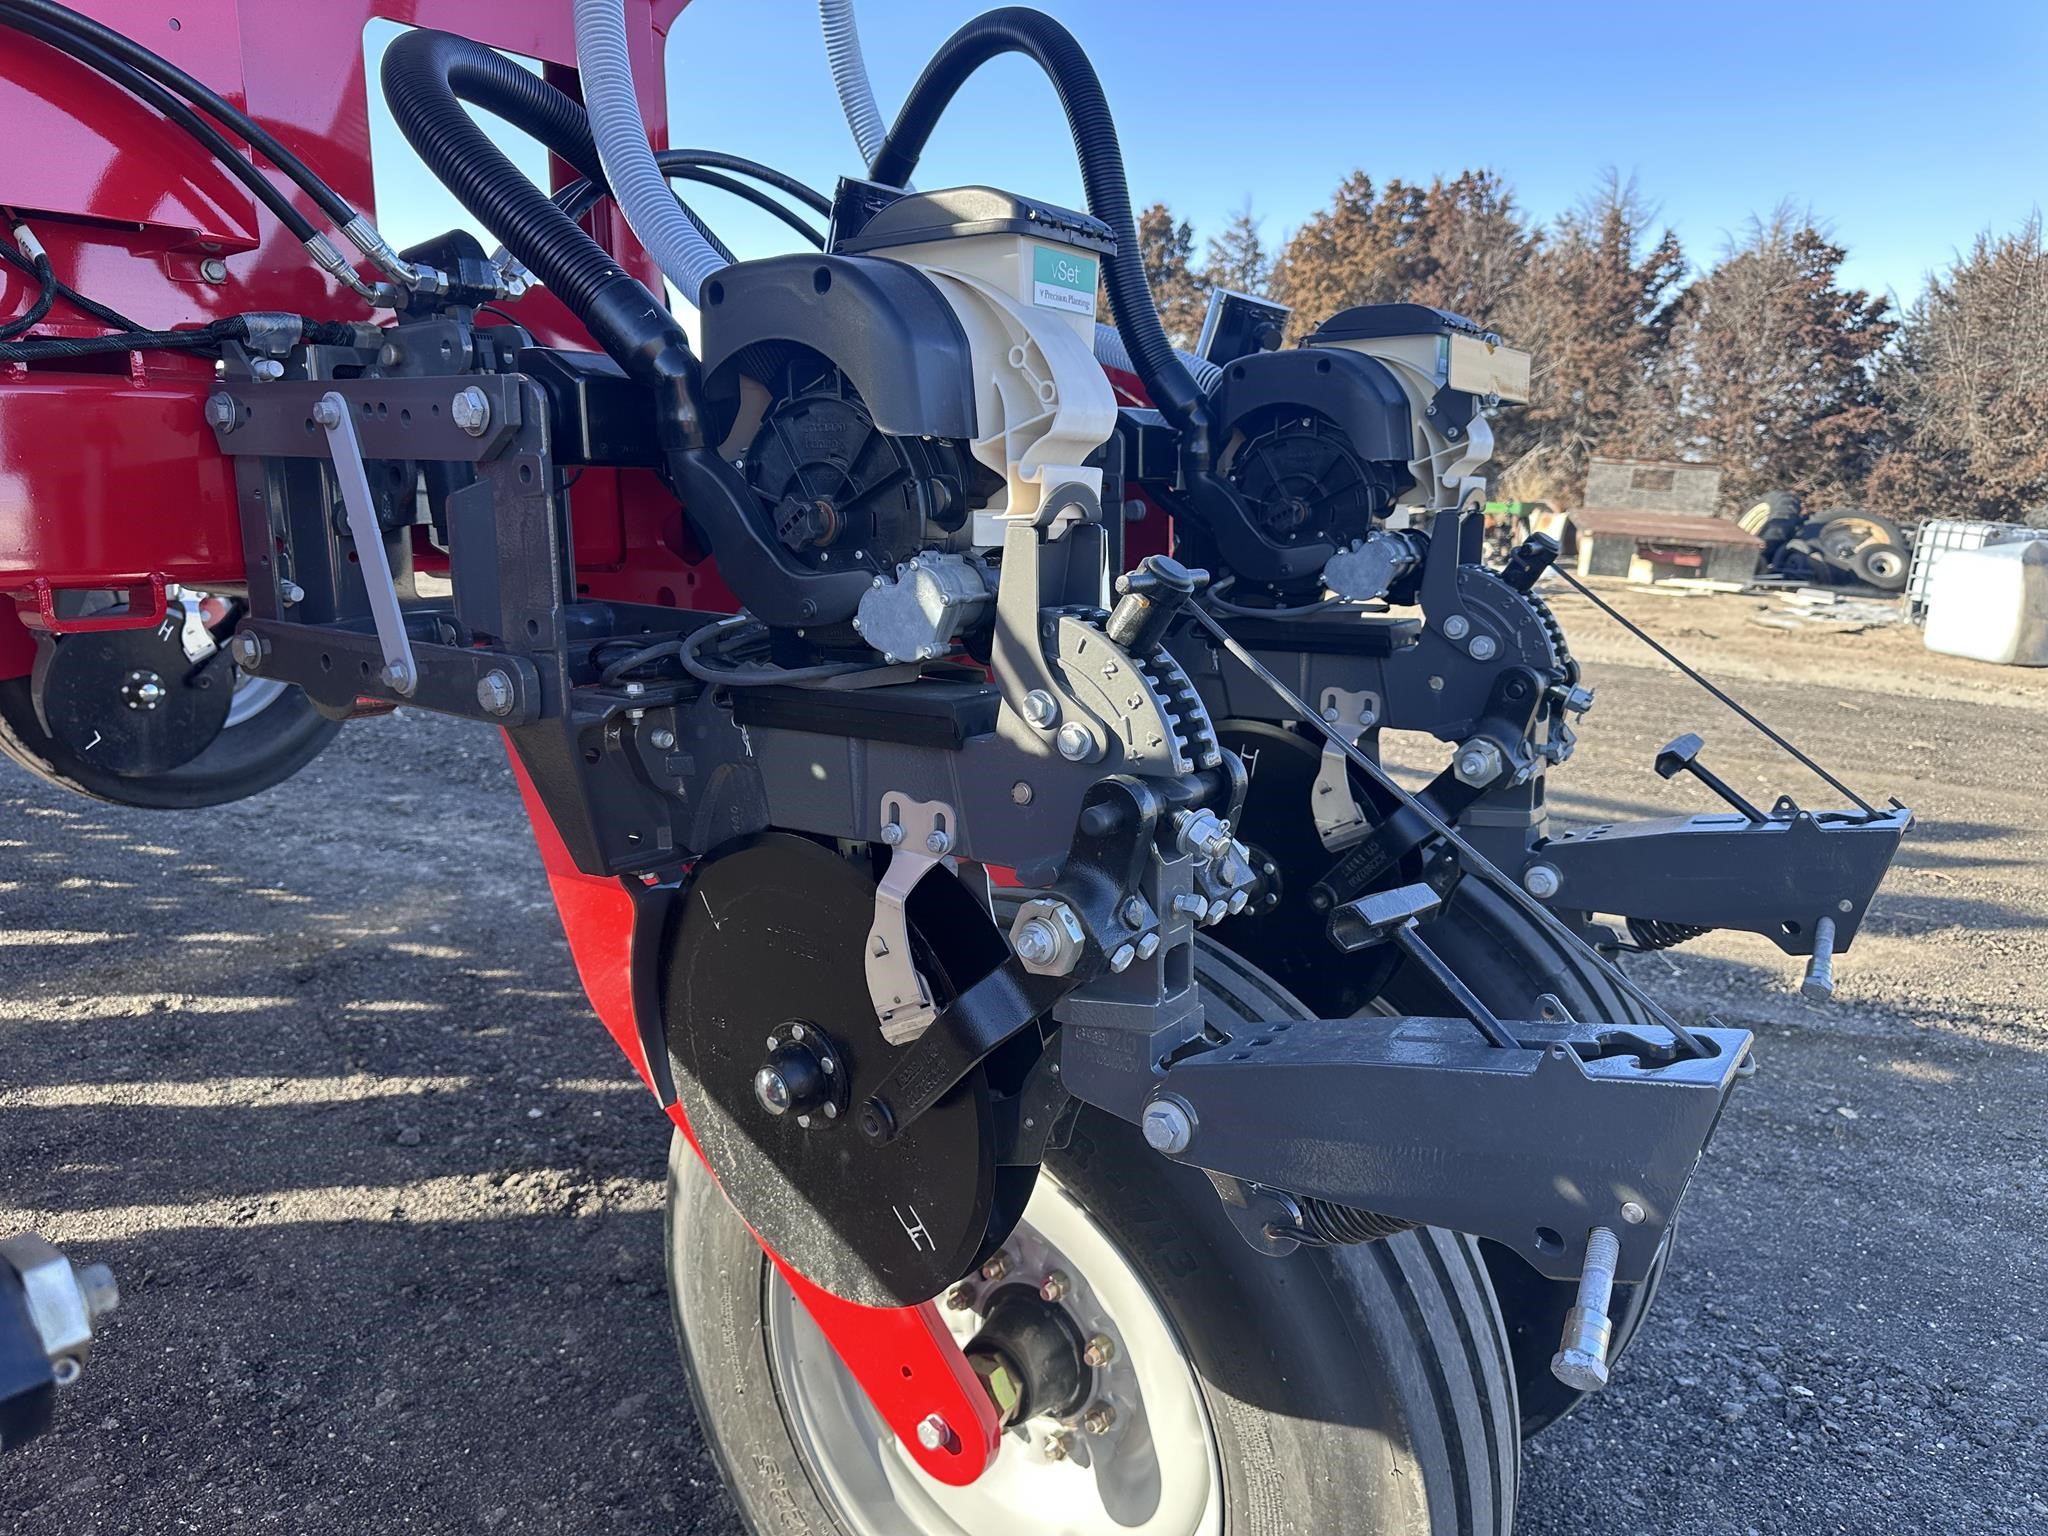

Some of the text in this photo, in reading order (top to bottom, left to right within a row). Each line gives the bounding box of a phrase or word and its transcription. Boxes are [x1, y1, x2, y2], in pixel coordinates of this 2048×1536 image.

[1051, 260, 1080, 284] vSet
[1044, 289, 1091, 311] Precision Planting
[1102, 657, 1119, 680] 2
[1127, 691, 1144, 710] 3
